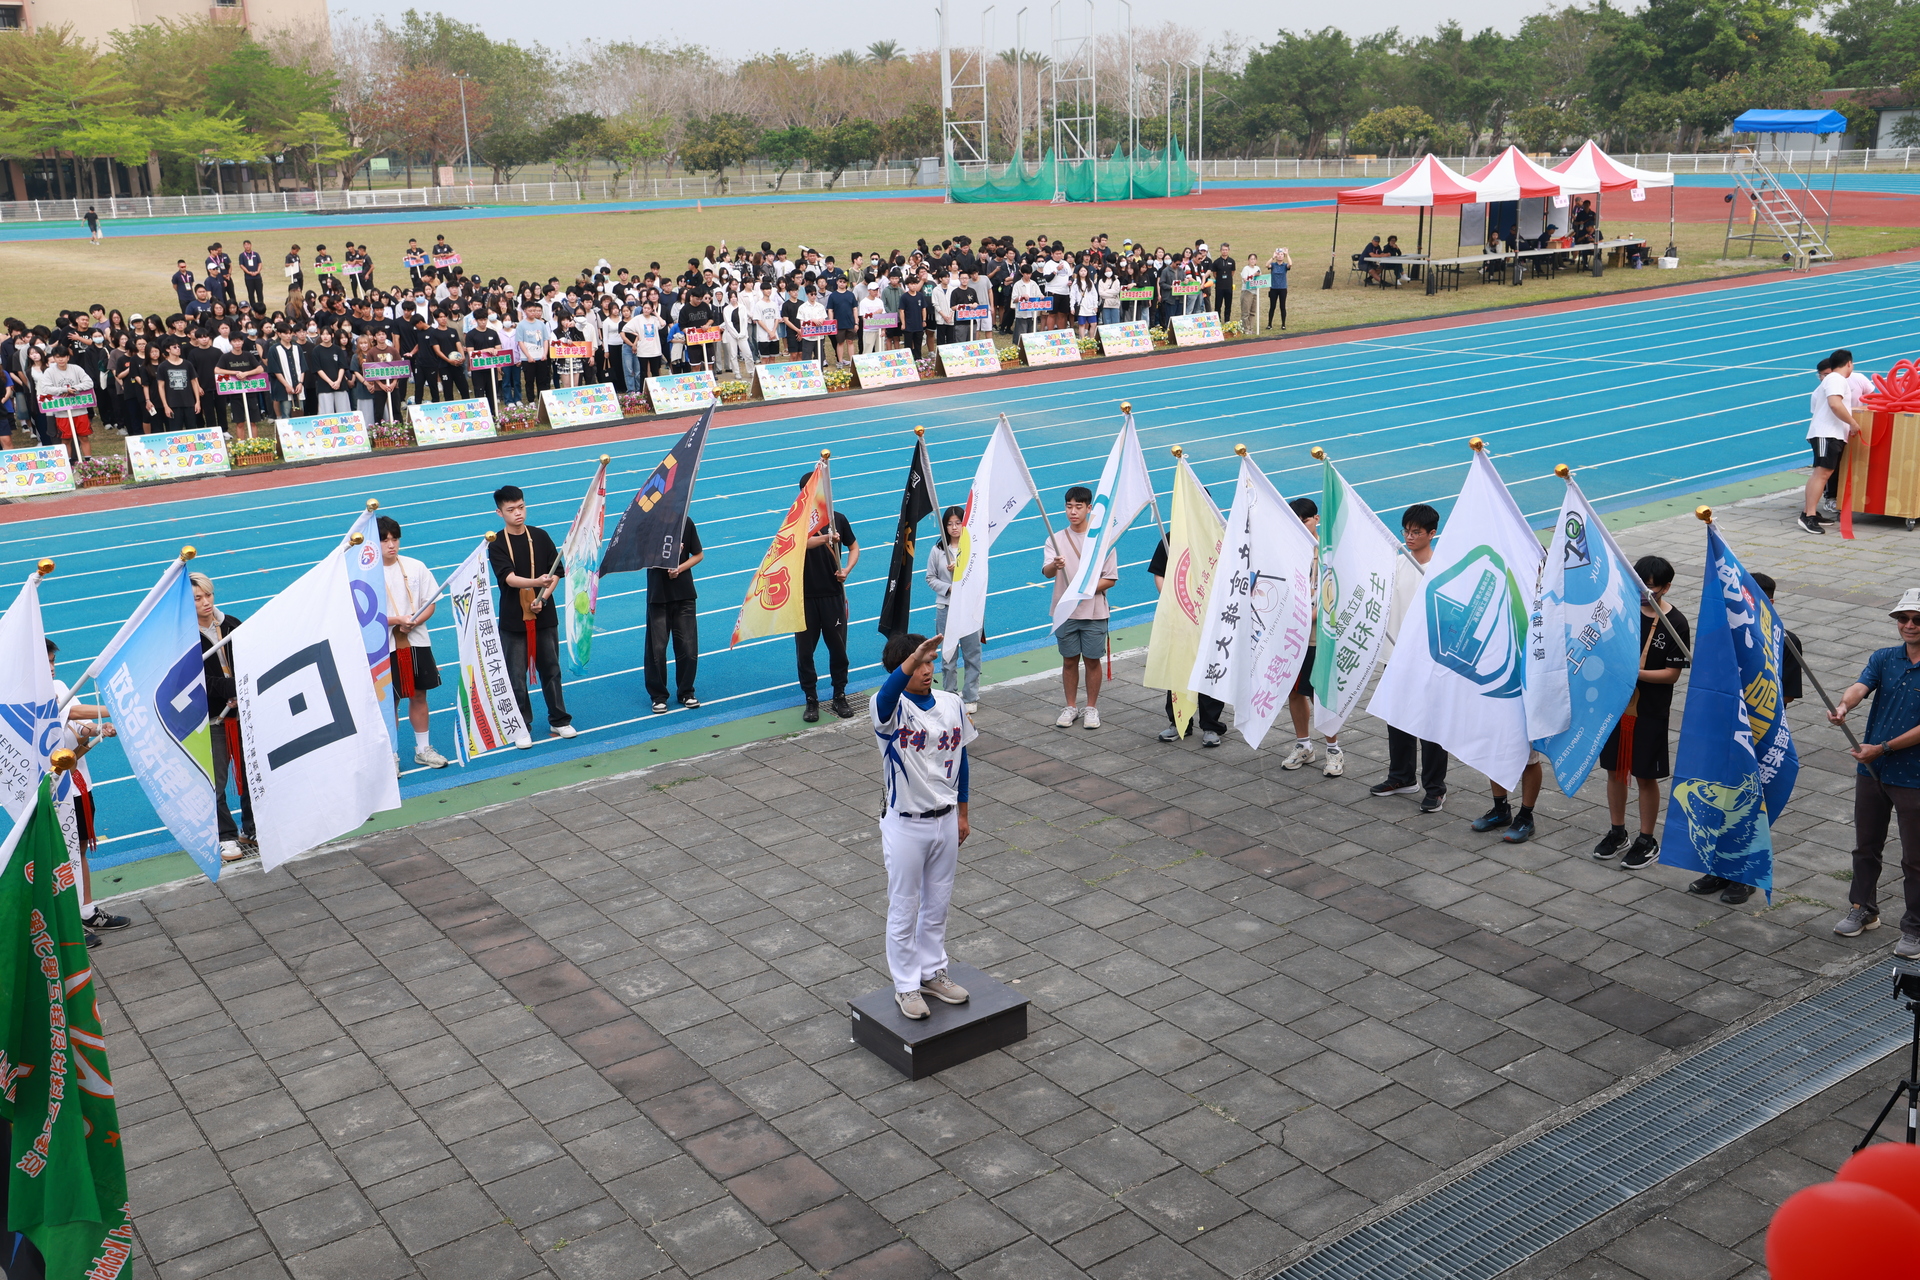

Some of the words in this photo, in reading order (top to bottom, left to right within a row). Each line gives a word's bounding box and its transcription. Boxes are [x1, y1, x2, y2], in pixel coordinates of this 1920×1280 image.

[1250, 279, 1268, 287] EMBA
[556, 346, 587, 356] 法律學系
[219, 378, 266, 392] 西洋語文學系
[197, 432, 219, 441] NUK
[39, 449, 63, 459] NUK
[108, 661, 219, 856] 政治法律學系
[944, 759, 954, 779] 7
[104, 685, 129, 743] Department
[137, 761, 178, 823] Government
[197, 843, 216, 866] Law
